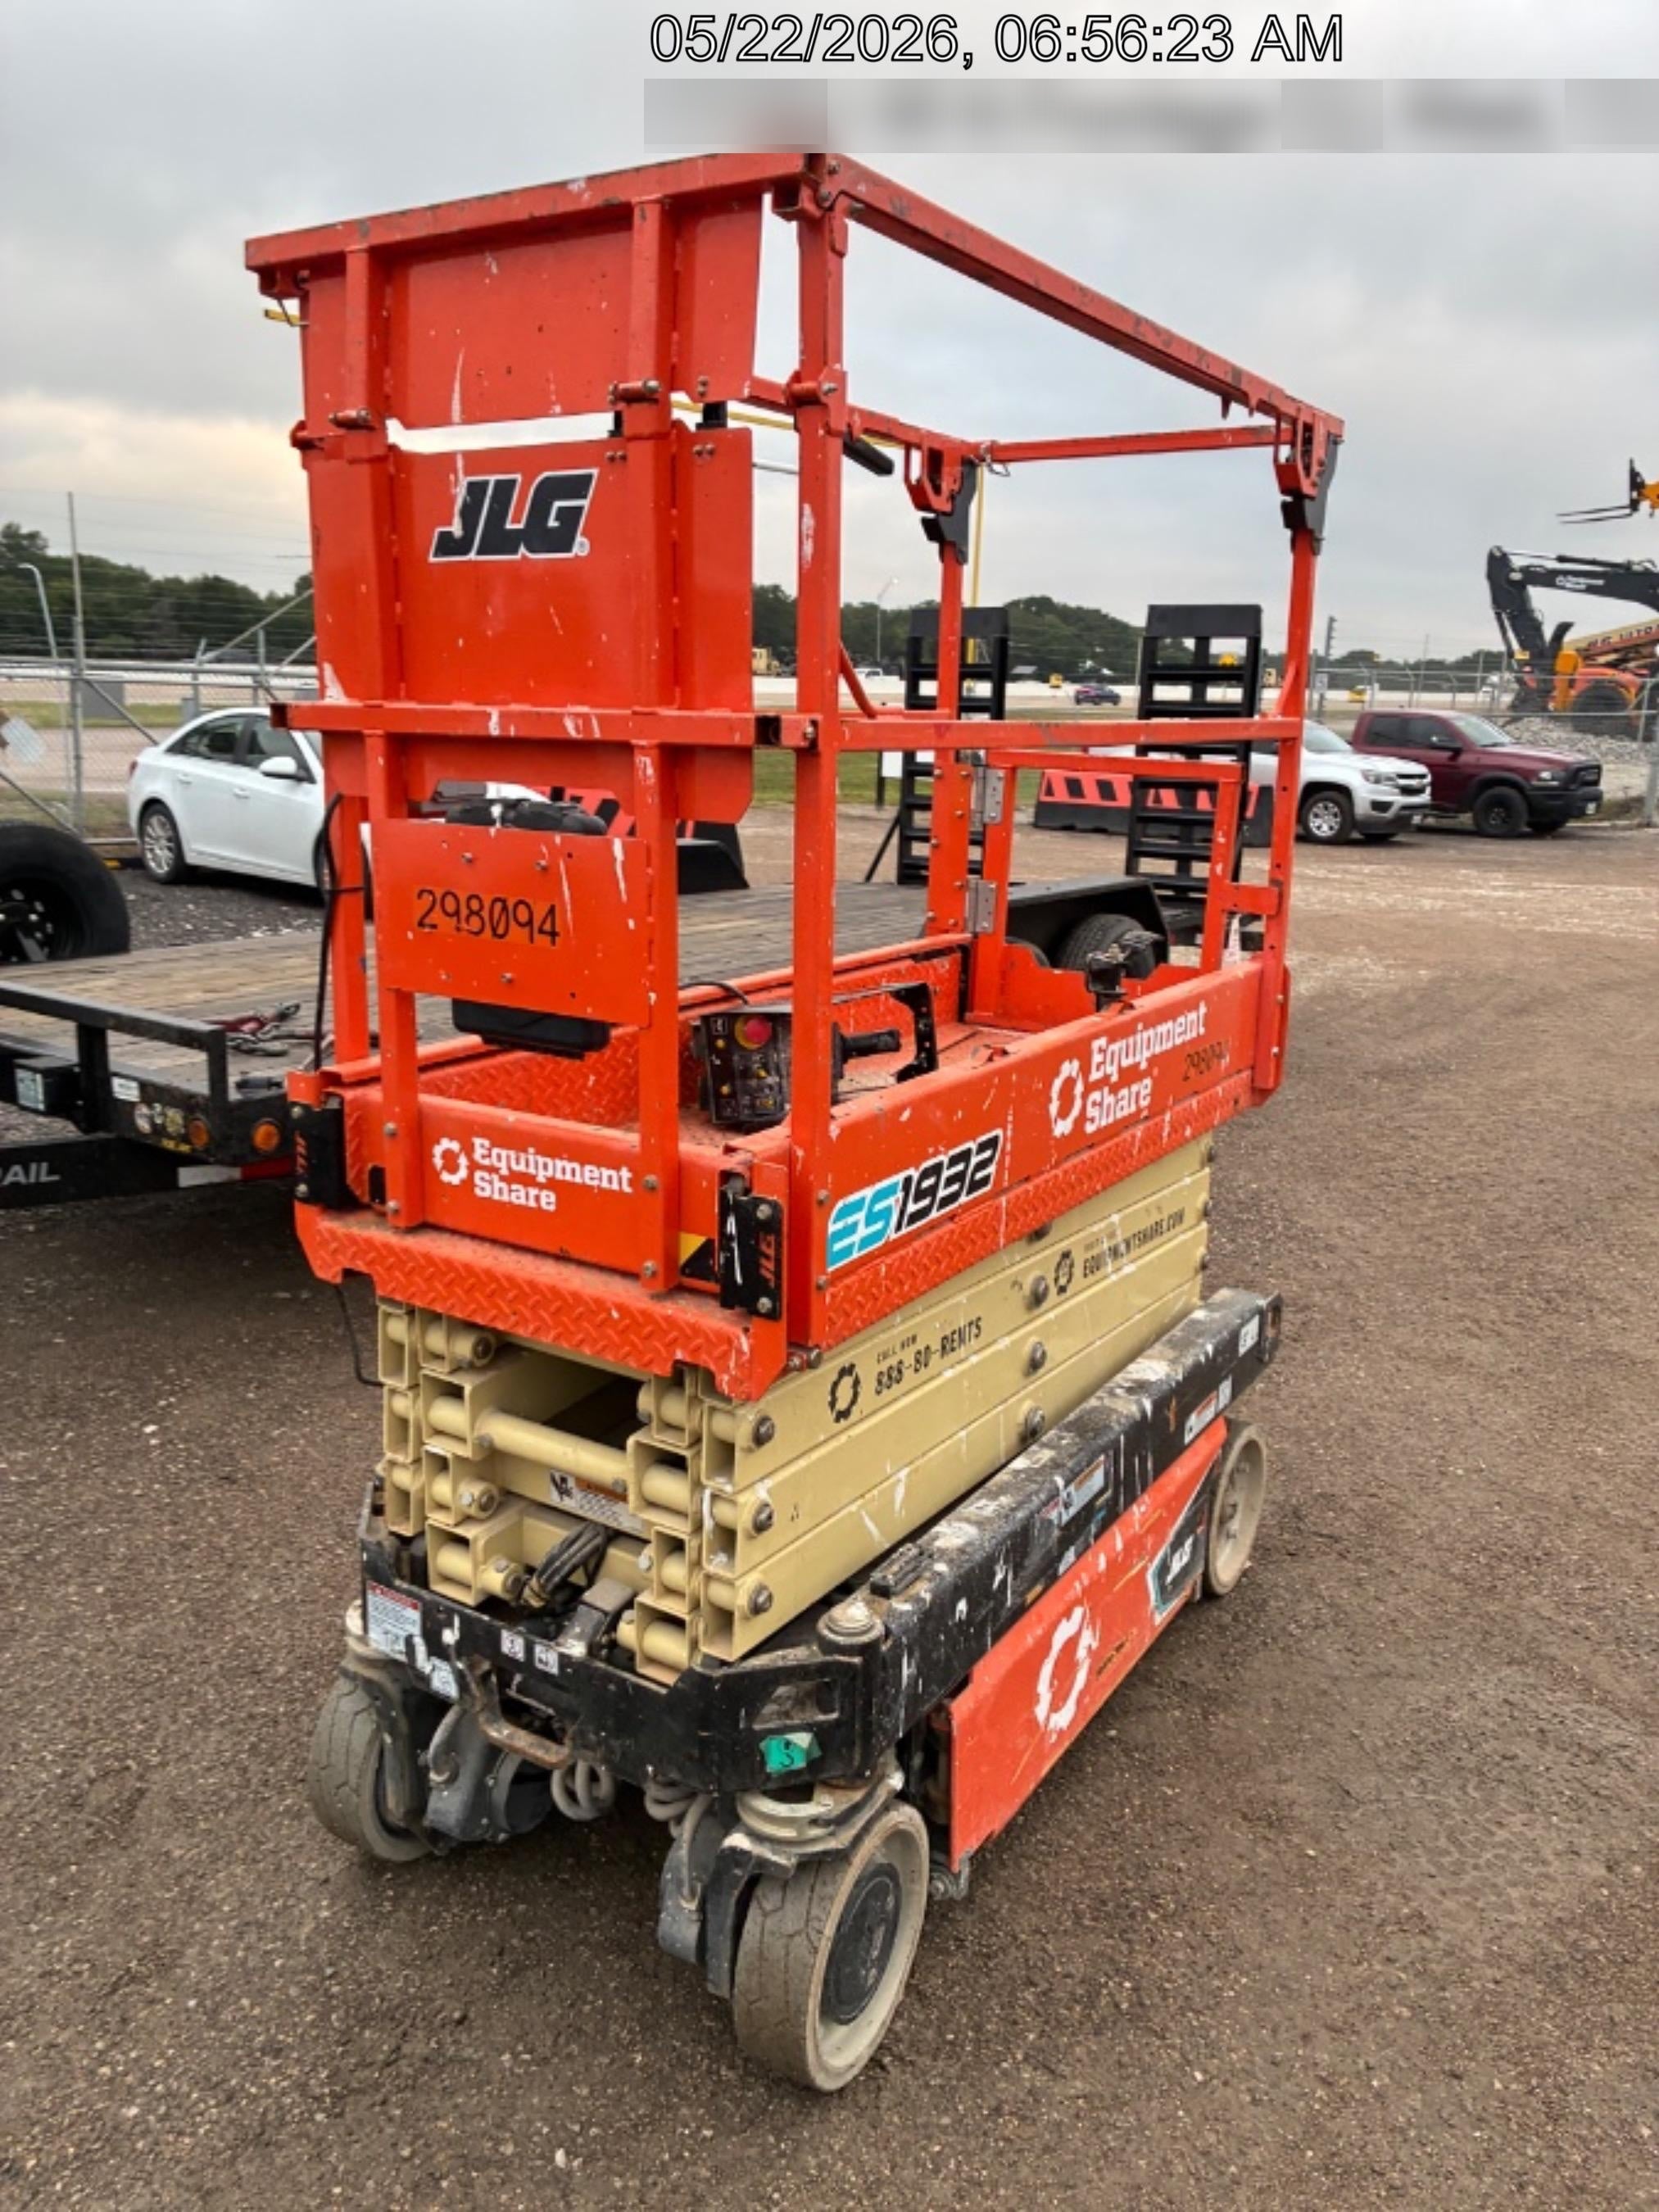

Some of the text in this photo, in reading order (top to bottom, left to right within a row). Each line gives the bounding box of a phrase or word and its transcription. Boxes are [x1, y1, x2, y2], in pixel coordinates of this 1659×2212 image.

[428, 467, 600, 563] JLG
[416, 888, 561, 947] 298094
[1089, 1000, 1207, 1083] Equipment
[1084, 1077, 1152, 1135] Share
[0, 1162, 61, 1185] AIL
[471, 1136, 633, 1194] Equipment
[473, 1170, 557, 1213] Share
[827, 1127, 1004, 1273] ES1932
[759, 1231, 776, 1289] JLG
